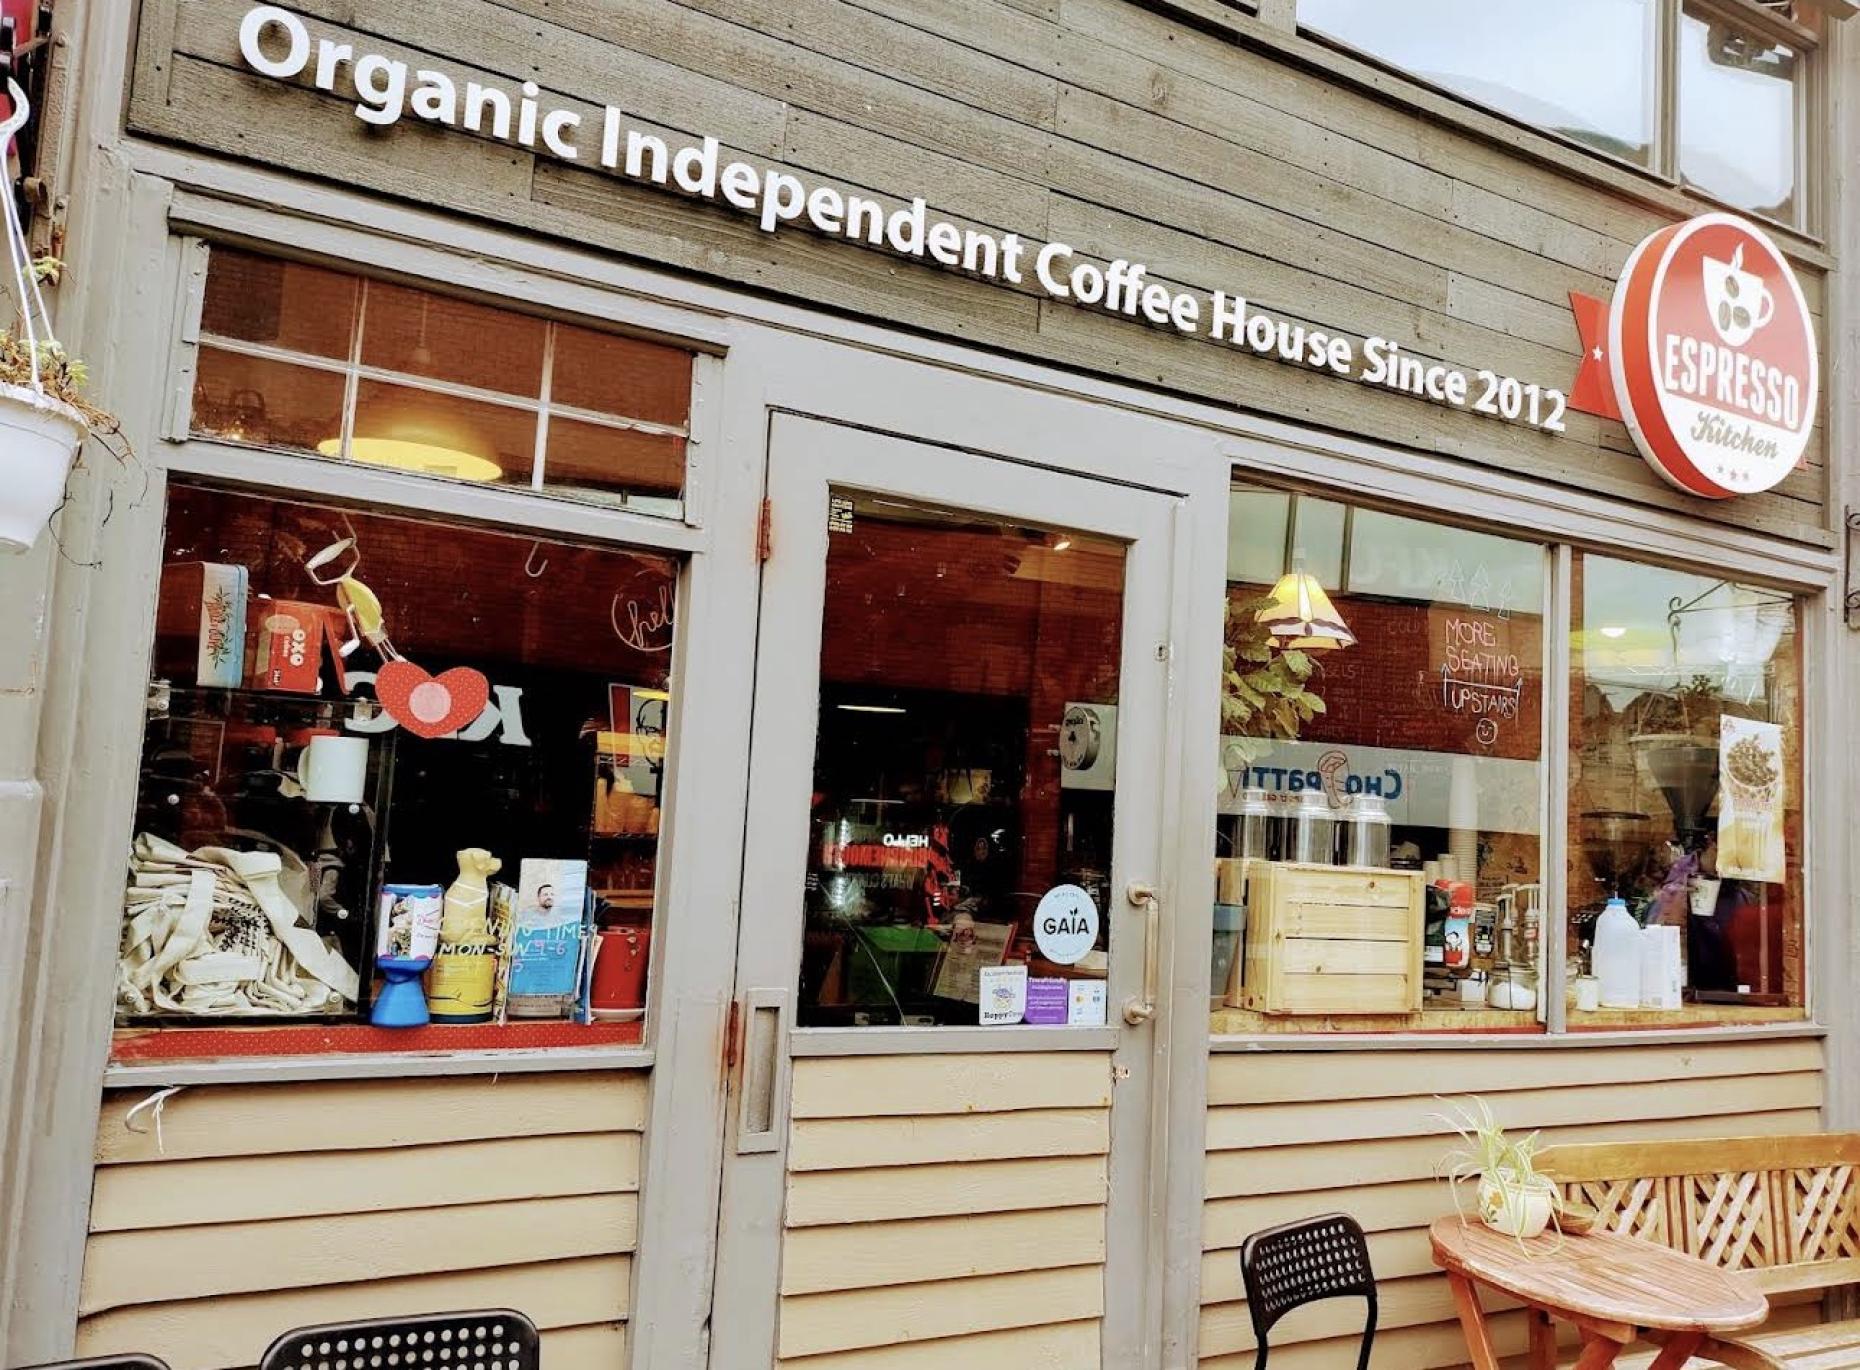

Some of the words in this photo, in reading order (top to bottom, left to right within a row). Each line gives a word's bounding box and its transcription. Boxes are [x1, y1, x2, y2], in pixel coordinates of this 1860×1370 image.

[238, 5, 582, 159] Organic
[599, 104, 1024, 284] Independent
[1035, 241, 1199, 334] Coffee
[1210, 290, 1352, 375] House
[1361, 334, 1468, 407] Since
[1474, 370, 1567, 432] 2012
[1664, 334, 1799, 430] ESPRESSO
[1690, 411, 1779, 459] Kitchen
[290, 628, 306, 666] OXO
[1445, 618, 1496, 647] MORE
[1445, 646, 1520, 677] SEATING
[1451, 685, 1518, 718] UPSTAIRS
